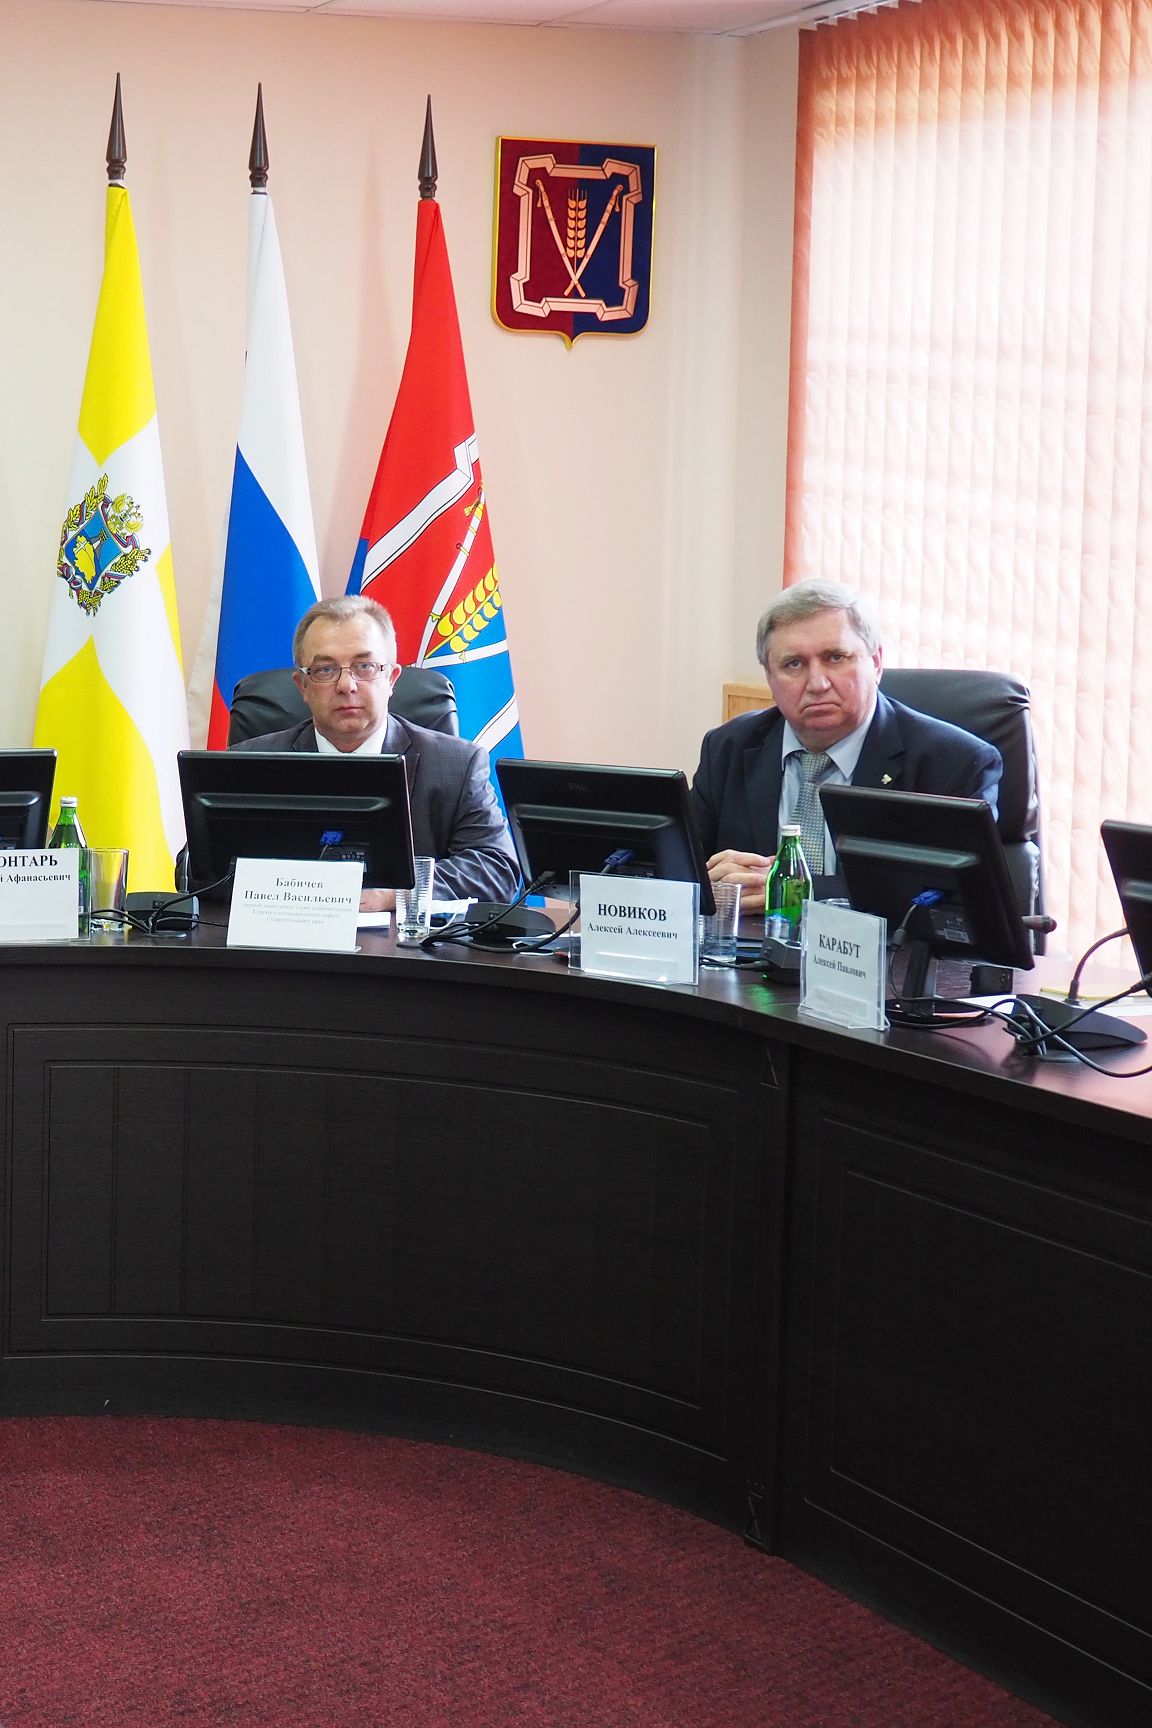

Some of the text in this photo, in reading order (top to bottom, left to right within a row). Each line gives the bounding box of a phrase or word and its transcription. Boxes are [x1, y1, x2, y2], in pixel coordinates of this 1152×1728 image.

[6, 873, 71, 885] Афанасьевич
[276, 877, 324, 889] Бабичев
[244, 890, 352, 904] Павел Васильевич
[597, 903, 667, 921] НОВИКОВ
[588, 922, 678, 939] Алексей Алексеевич
[818, 933, 861, 959] КАРАБУТ
[812, 954, 867, 979] Алексей Павлович
